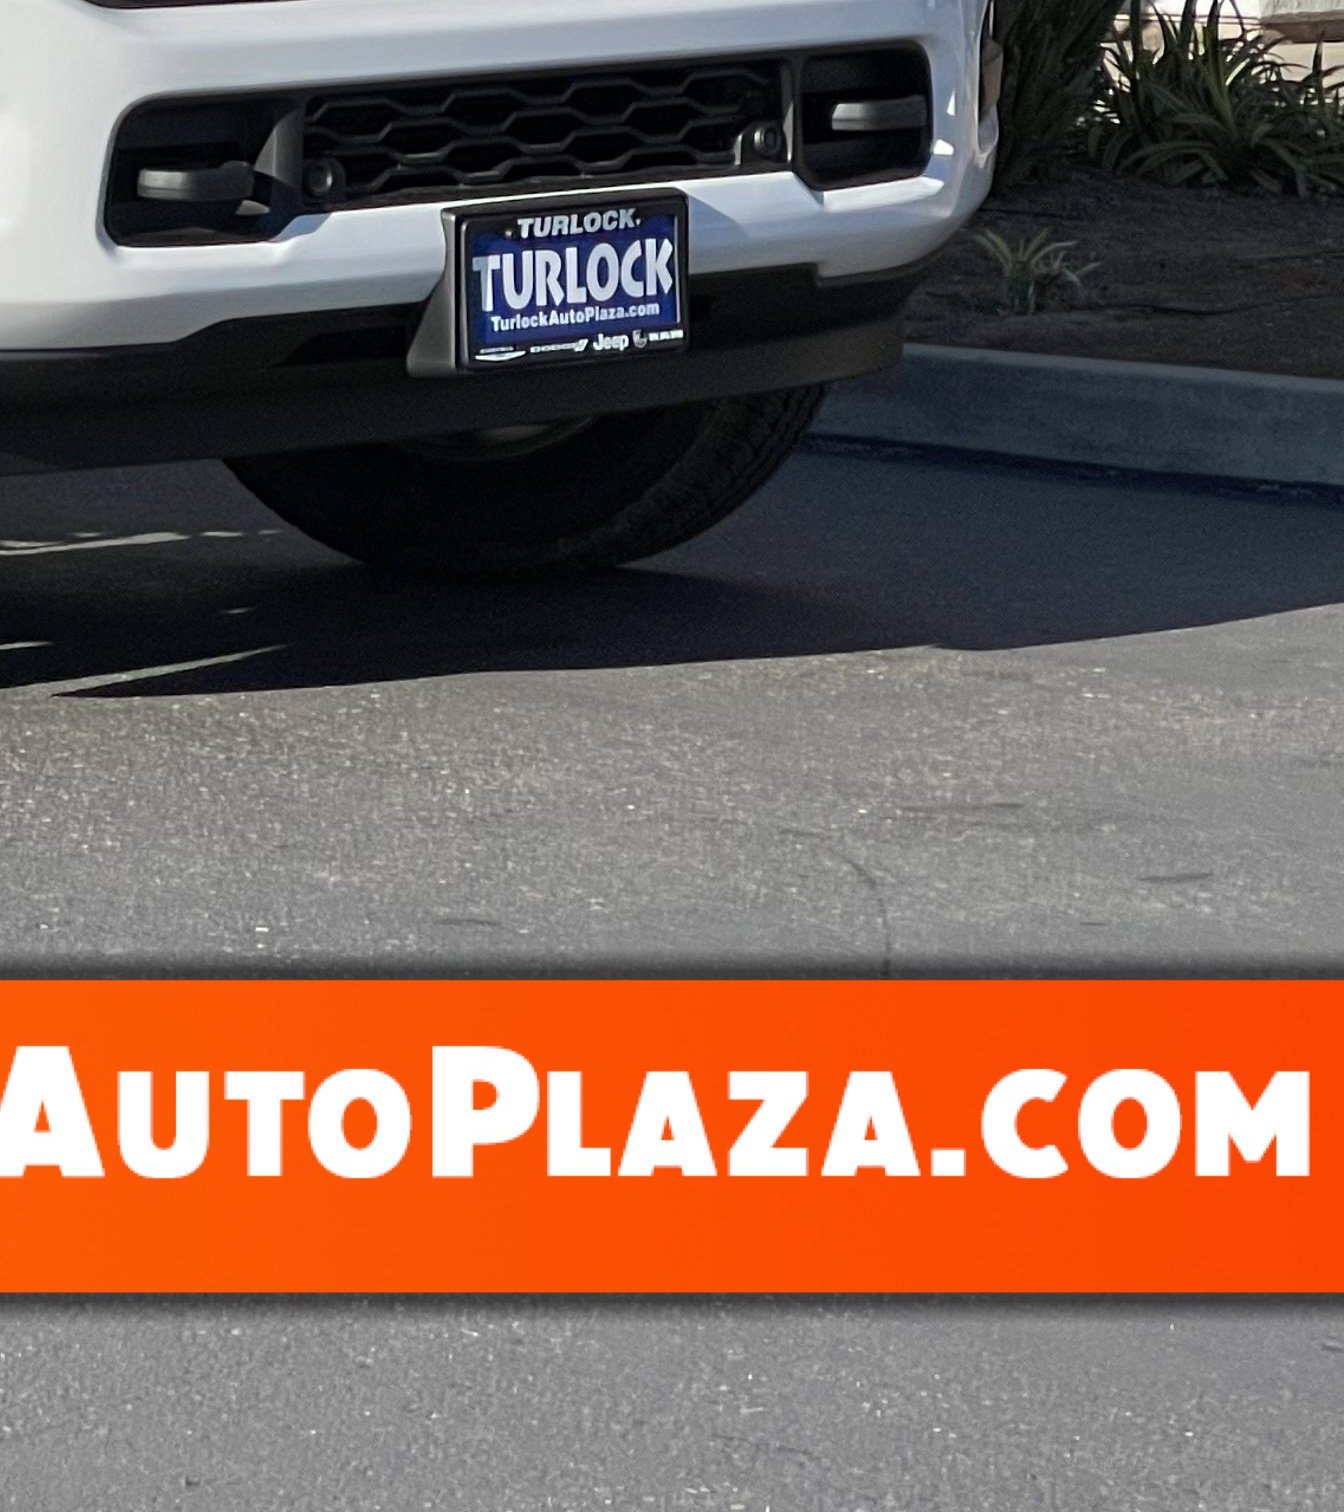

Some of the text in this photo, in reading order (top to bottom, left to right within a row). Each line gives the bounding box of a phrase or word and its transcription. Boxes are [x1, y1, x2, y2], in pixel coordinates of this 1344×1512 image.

[516, 207, 638, 239] TURLOCK
[472, 237, 675, 312] TURLOCK
[490, 301, 660, 332] TurlockAutoPlaza.com
[592, 333, 630, 352] Jeep
